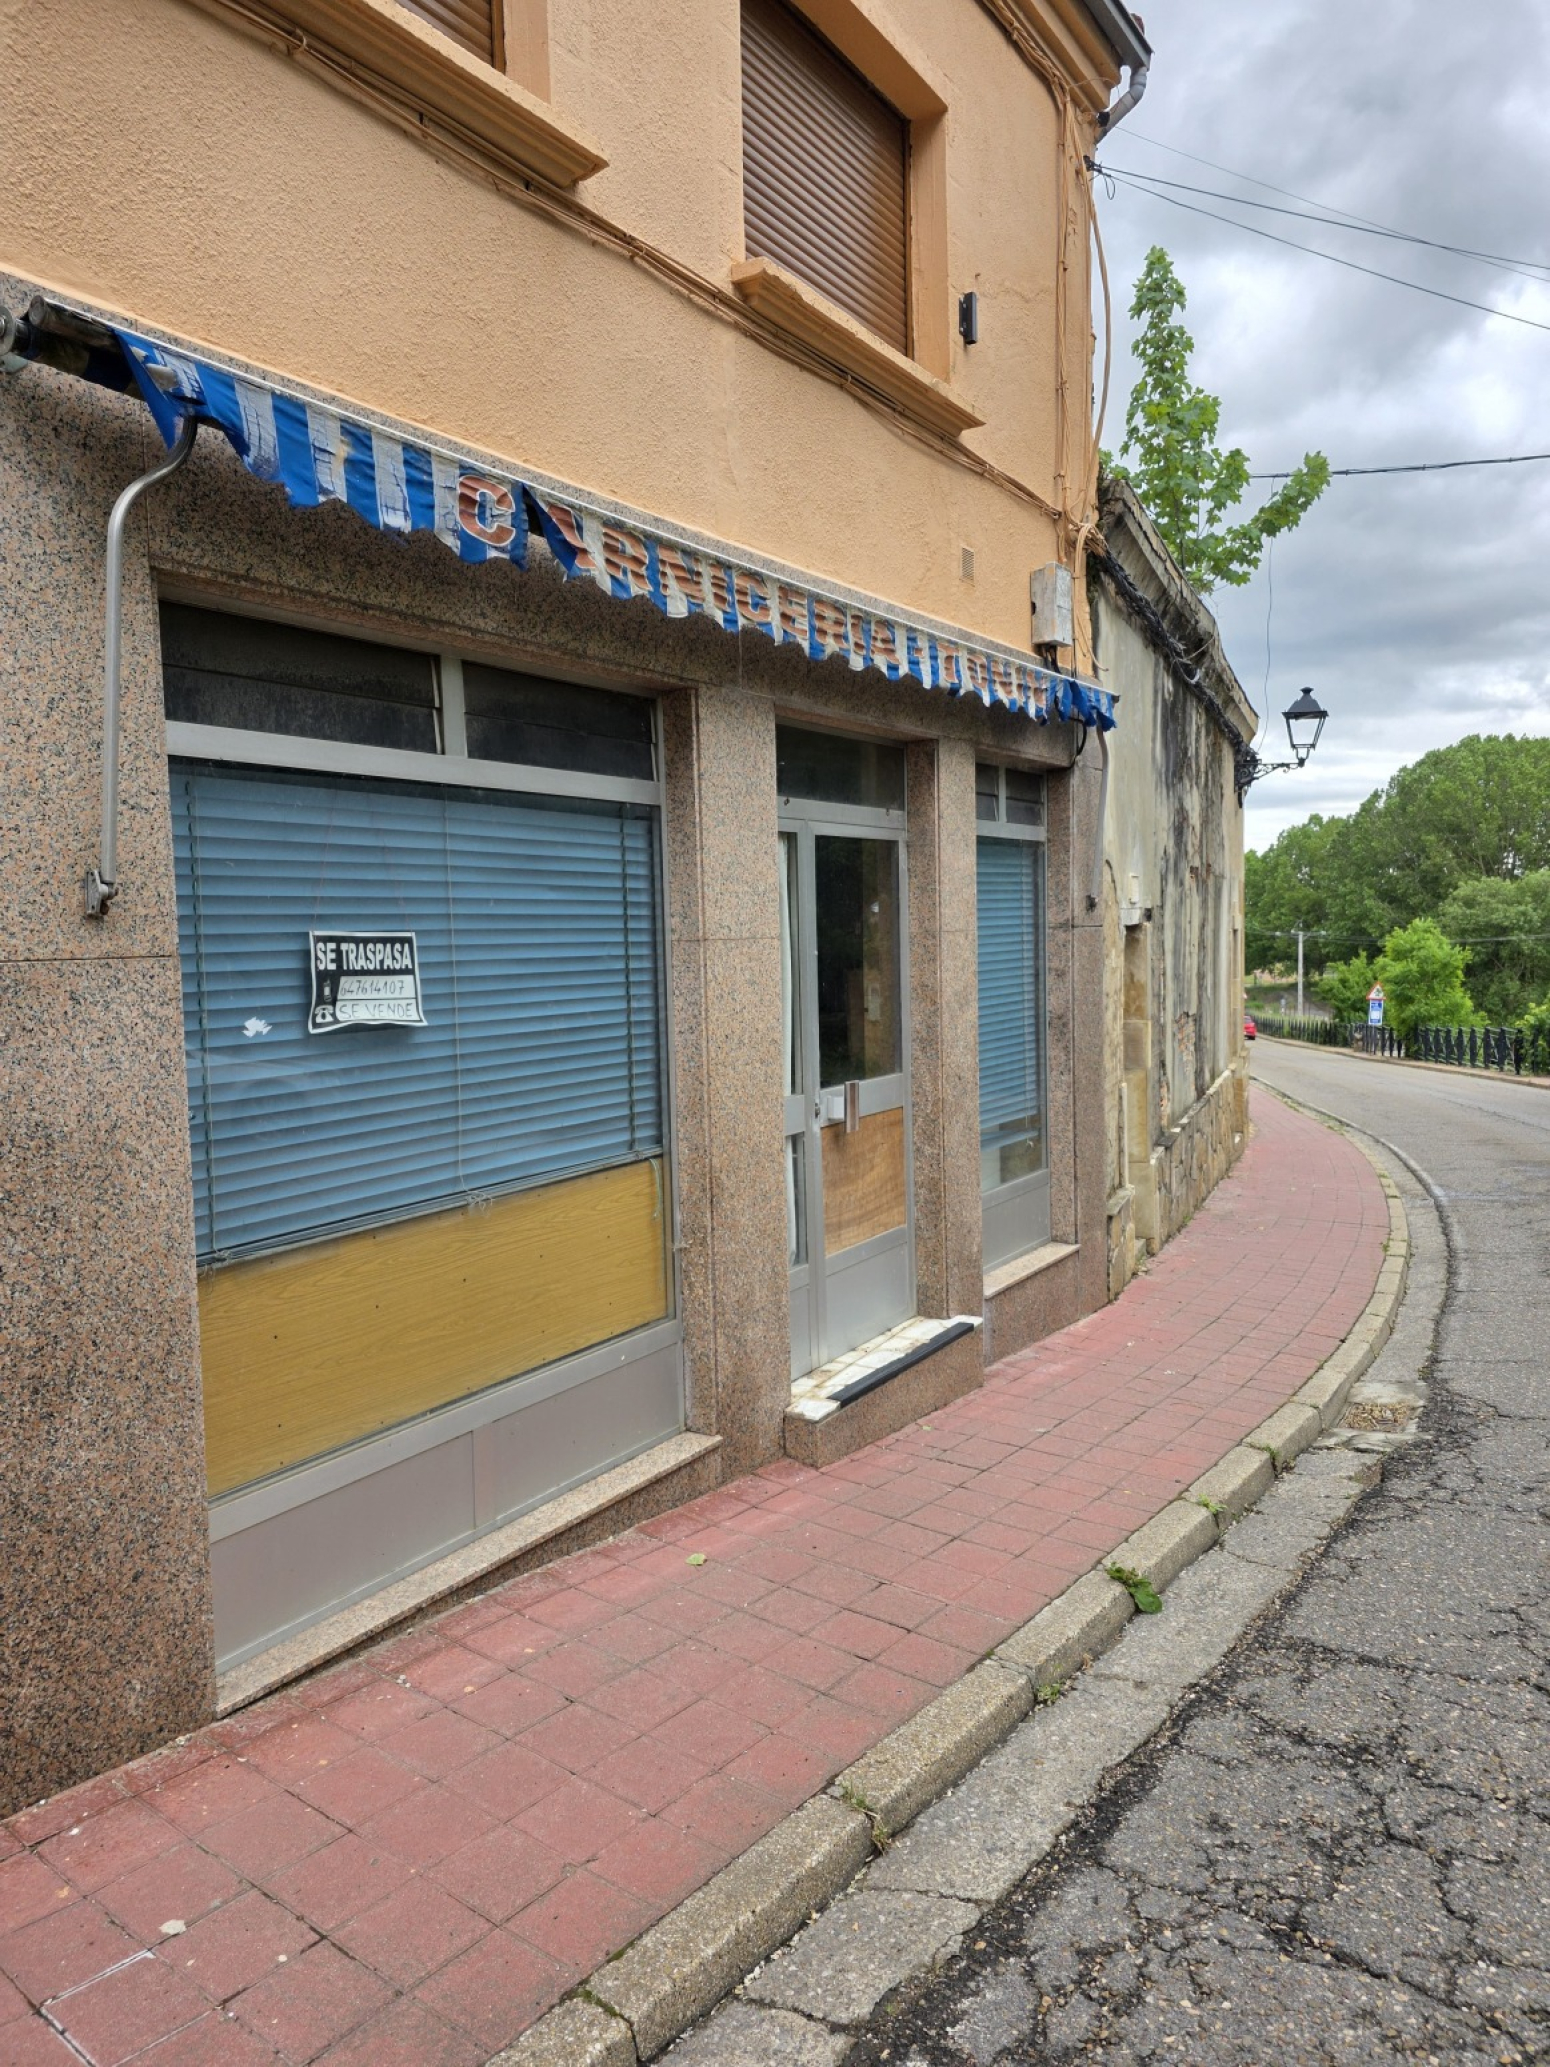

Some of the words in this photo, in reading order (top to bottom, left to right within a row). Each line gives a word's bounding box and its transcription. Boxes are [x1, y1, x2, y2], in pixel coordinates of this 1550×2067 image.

[315, 942, 336, 970] SE
[340, 942, 413, 970] TRASPASA
[339, 1003, 360, 1019] SE
[365, 1002, 413, 1019] VENDE
